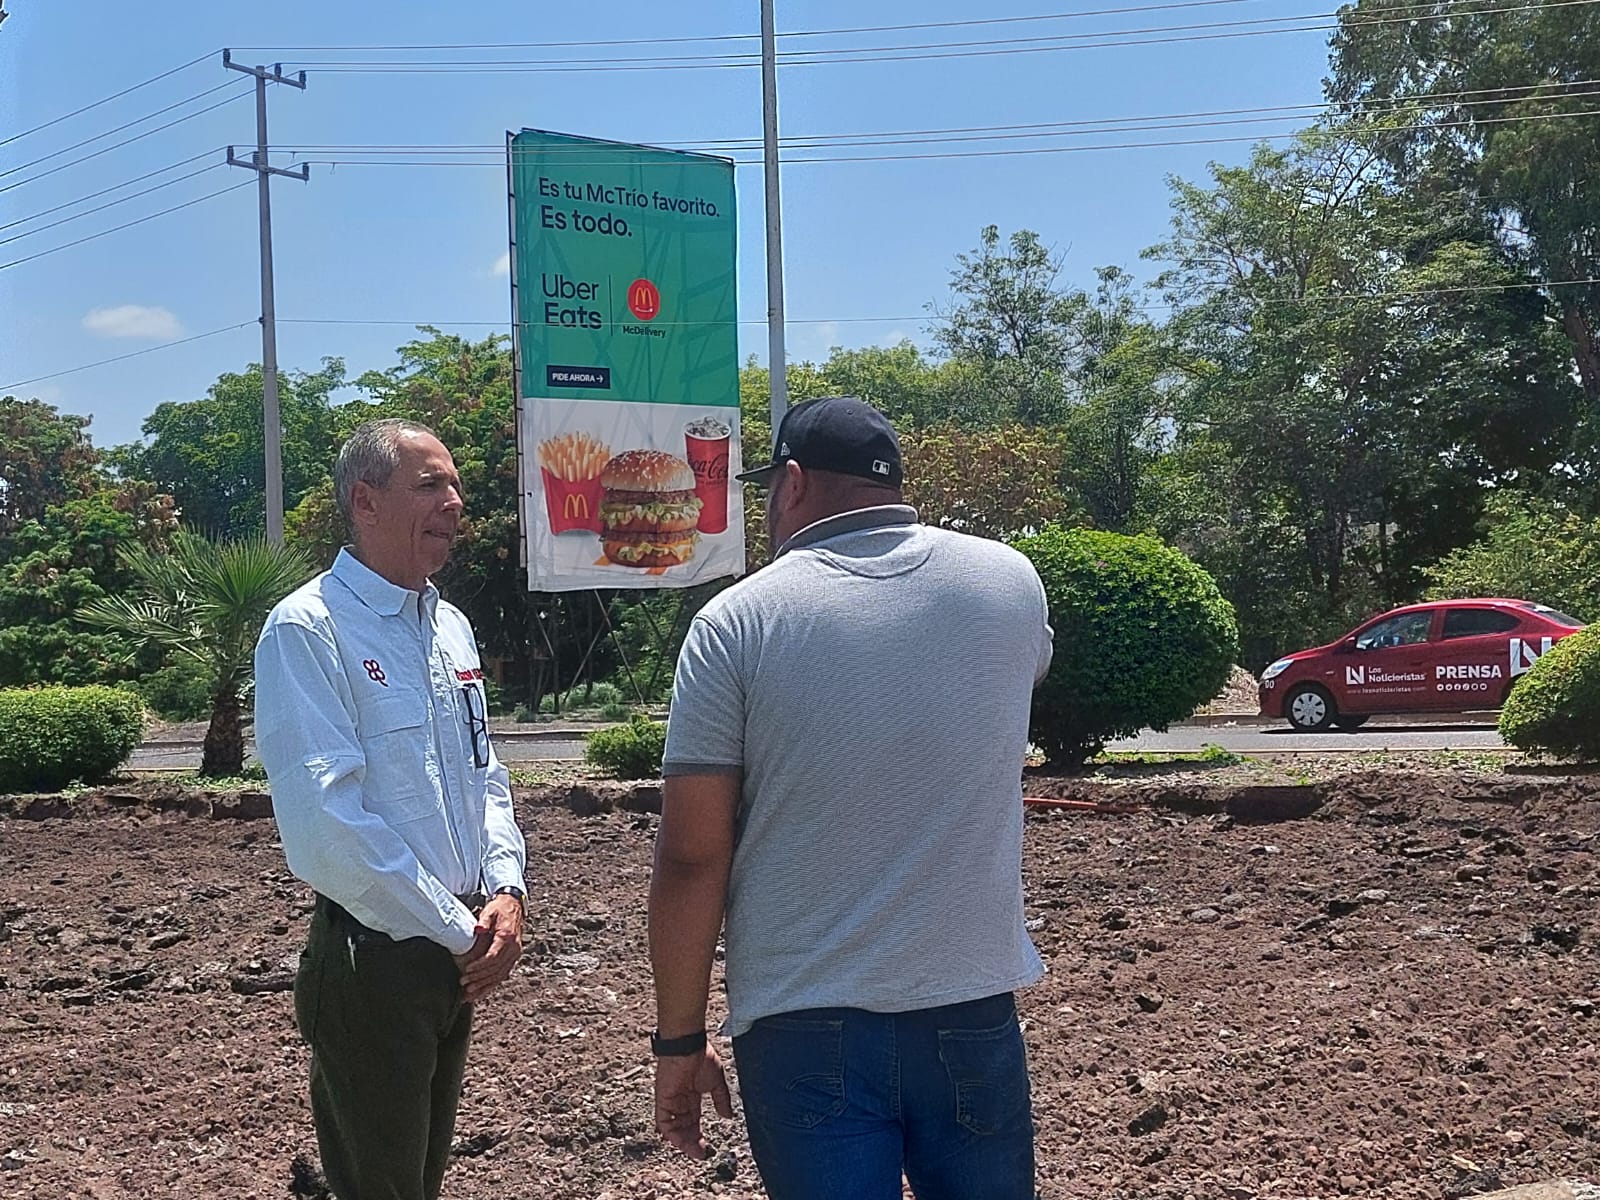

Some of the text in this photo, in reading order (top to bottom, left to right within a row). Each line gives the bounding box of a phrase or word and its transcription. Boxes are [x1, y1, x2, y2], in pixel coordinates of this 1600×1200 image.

[539, 177, 720, 217] Es tu McTrío favorito.
[541, 205, 632, 237] Es todo.
[542, 273, 599, 301] Uber
[544, 302, 602, 330] Eats
[623, 326, 666, 338] McDelivery
[552, 373, 595, 382] PIDE AHORA
[1368, 666, 1382, 674] Los
[1436, 665, 1502, 679] PRENSA
